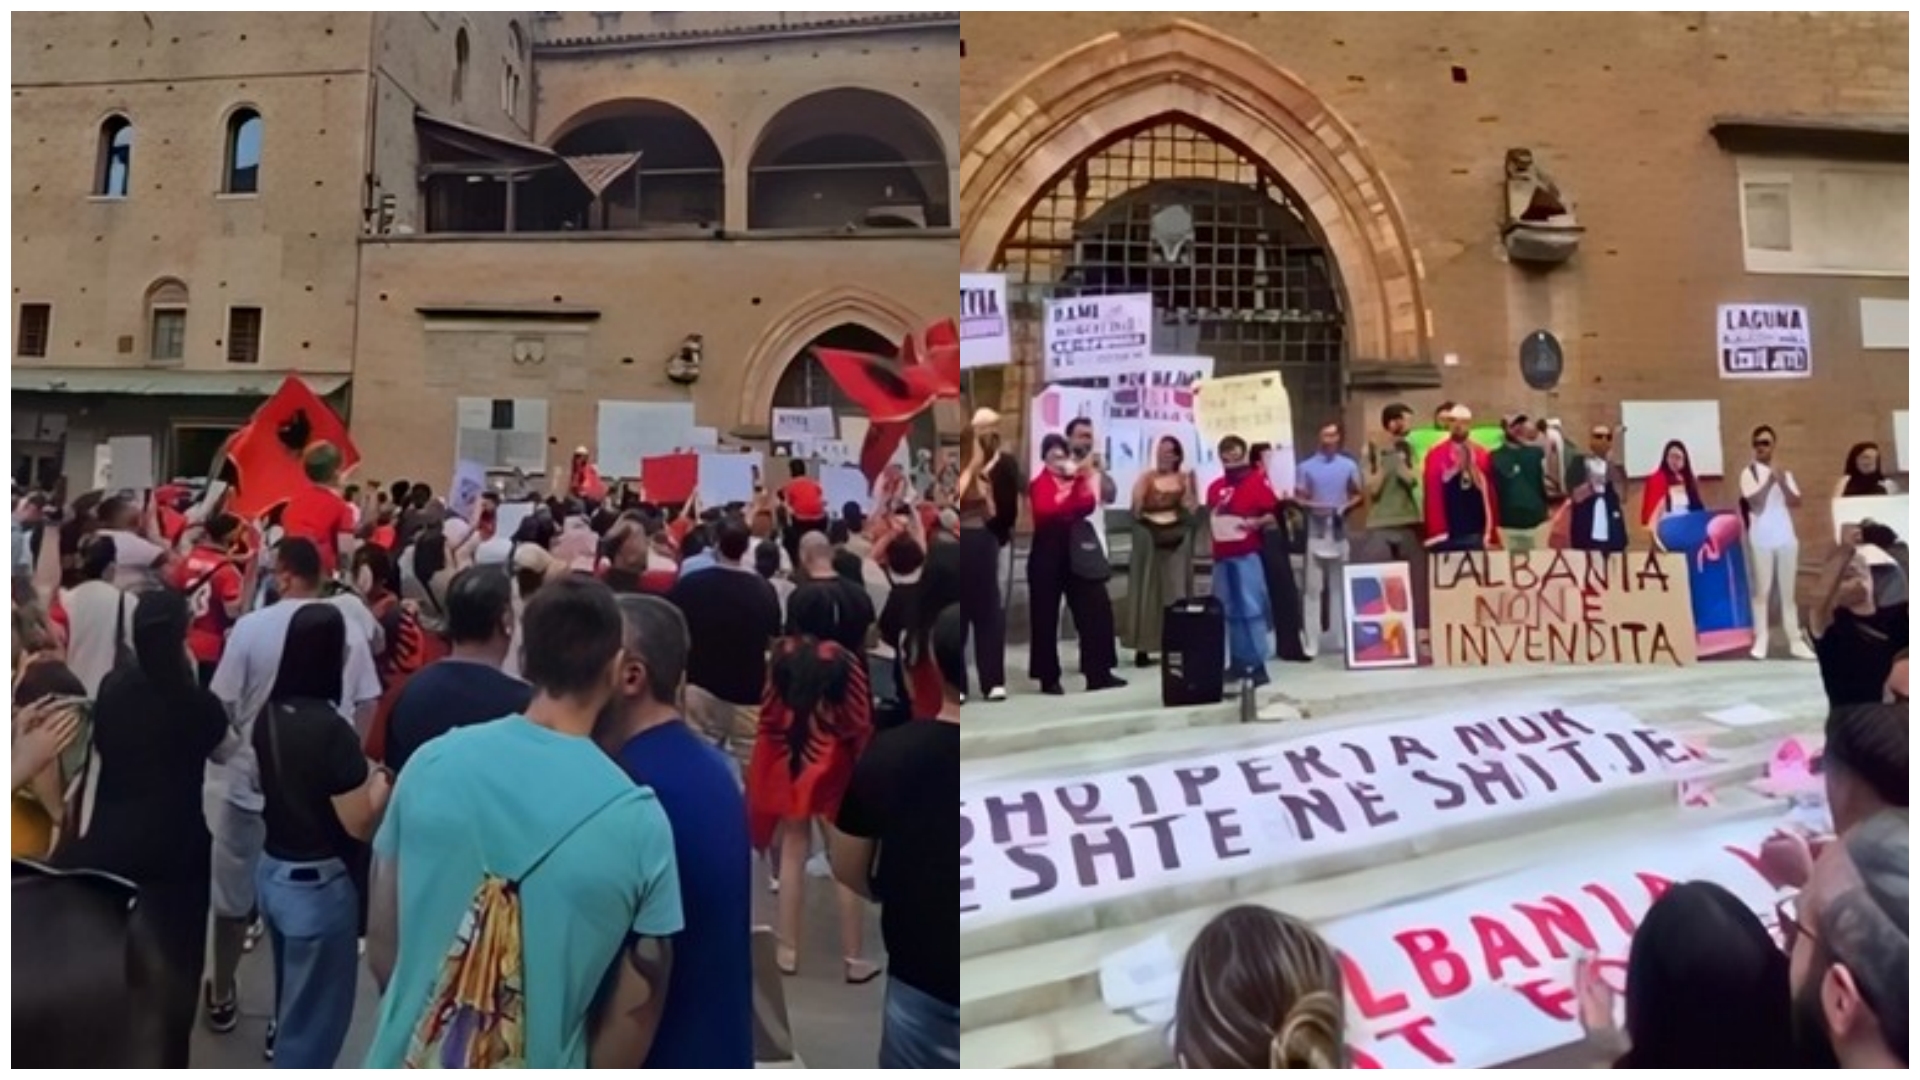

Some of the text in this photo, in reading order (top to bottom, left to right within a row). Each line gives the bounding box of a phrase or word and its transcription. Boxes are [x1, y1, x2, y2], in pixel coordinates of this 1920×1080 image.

[1727, 309, 1803, 330] LAGUNA
[1433, 550, 1670, 593] L'ALBANIA
[1475, 587, 1567, 628] NON
[1445, 622, 1684, 667] INVENDITA
[1453, 707, 1595, 756] NUK
[1412, 729, 1690, 810] SHITJE
